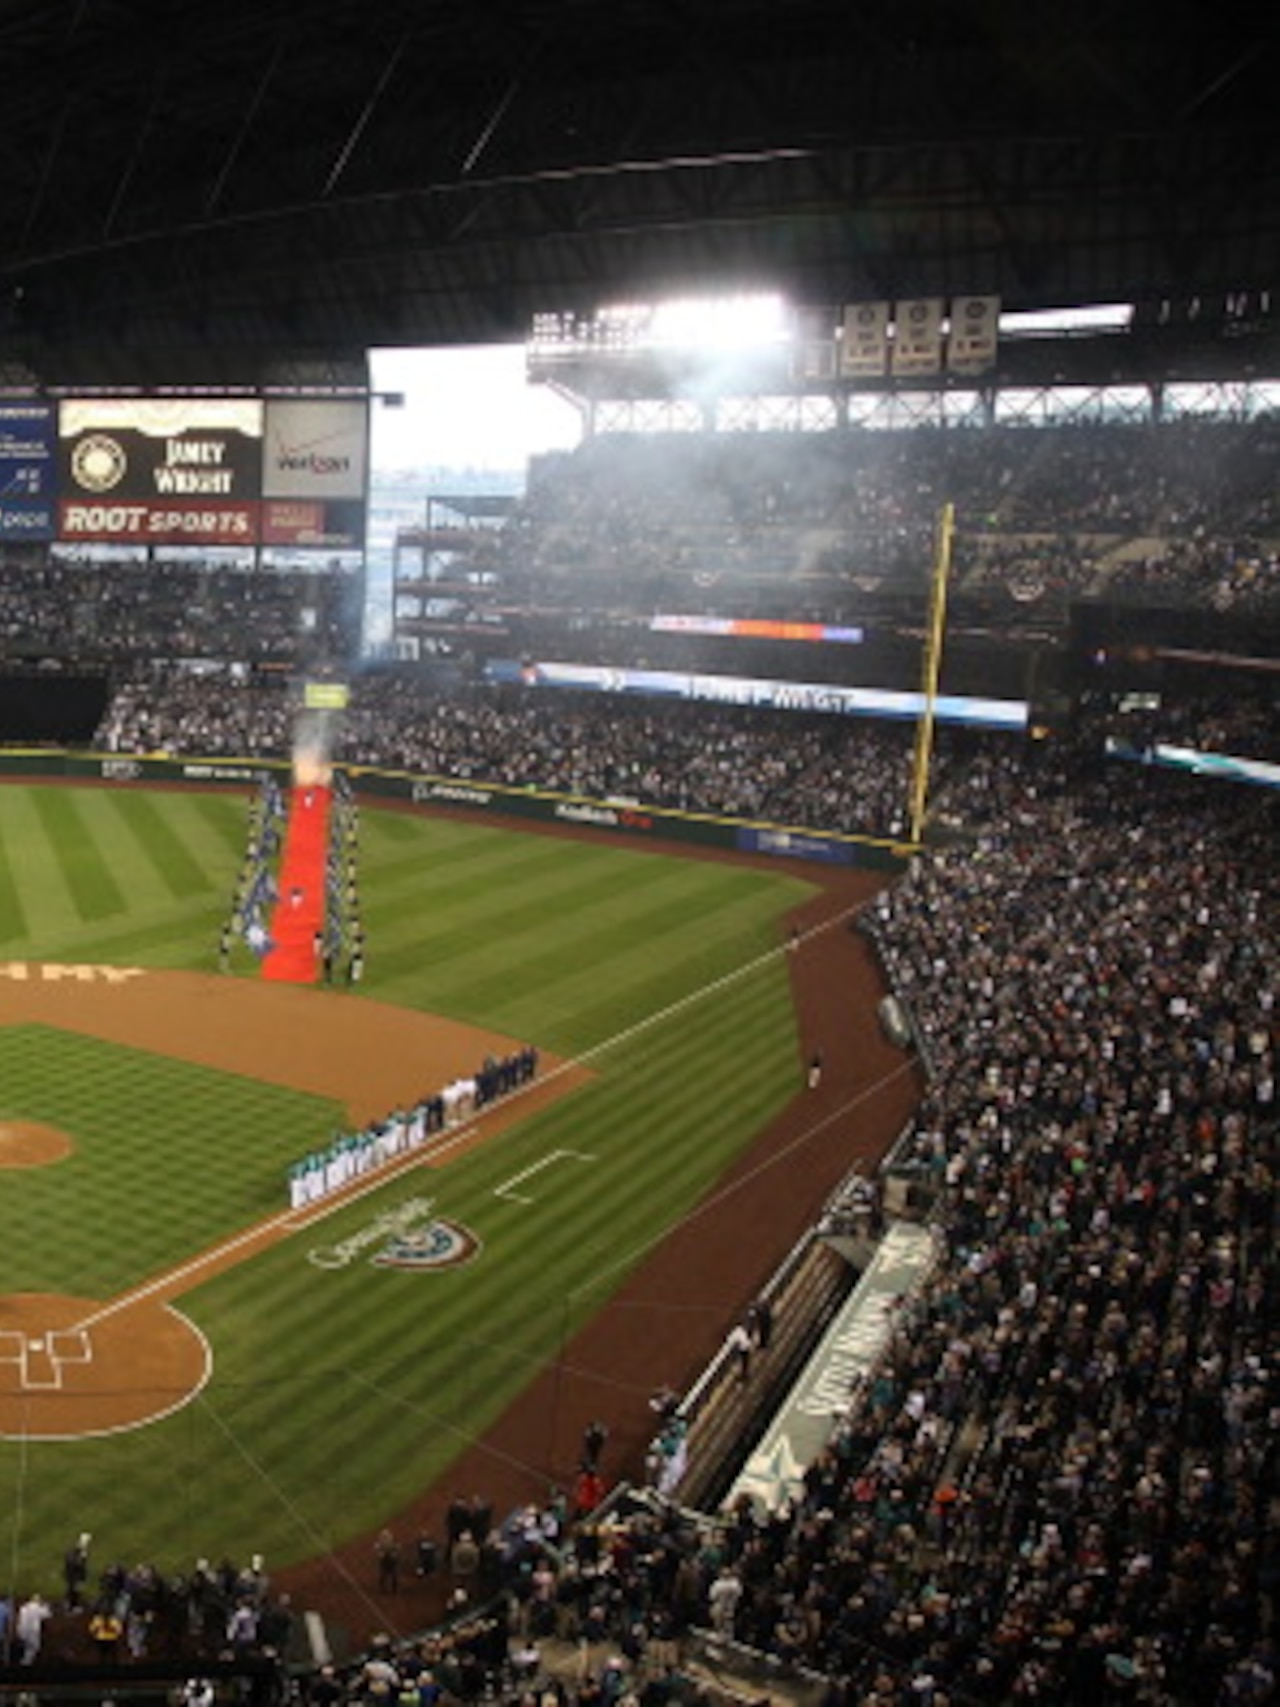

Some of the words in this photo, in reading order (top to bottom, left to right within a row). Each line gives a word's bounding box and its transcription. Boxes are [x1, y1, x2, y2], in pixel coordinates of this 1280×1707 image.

[166, 439, 225, 466] JAMEY
[153, 469, 233, 493] WRIGHT
[64, 507, 147, 531] ROOT
[149, 511, 248, 533] SPORTS
[42, 964, 145, 982] MY
